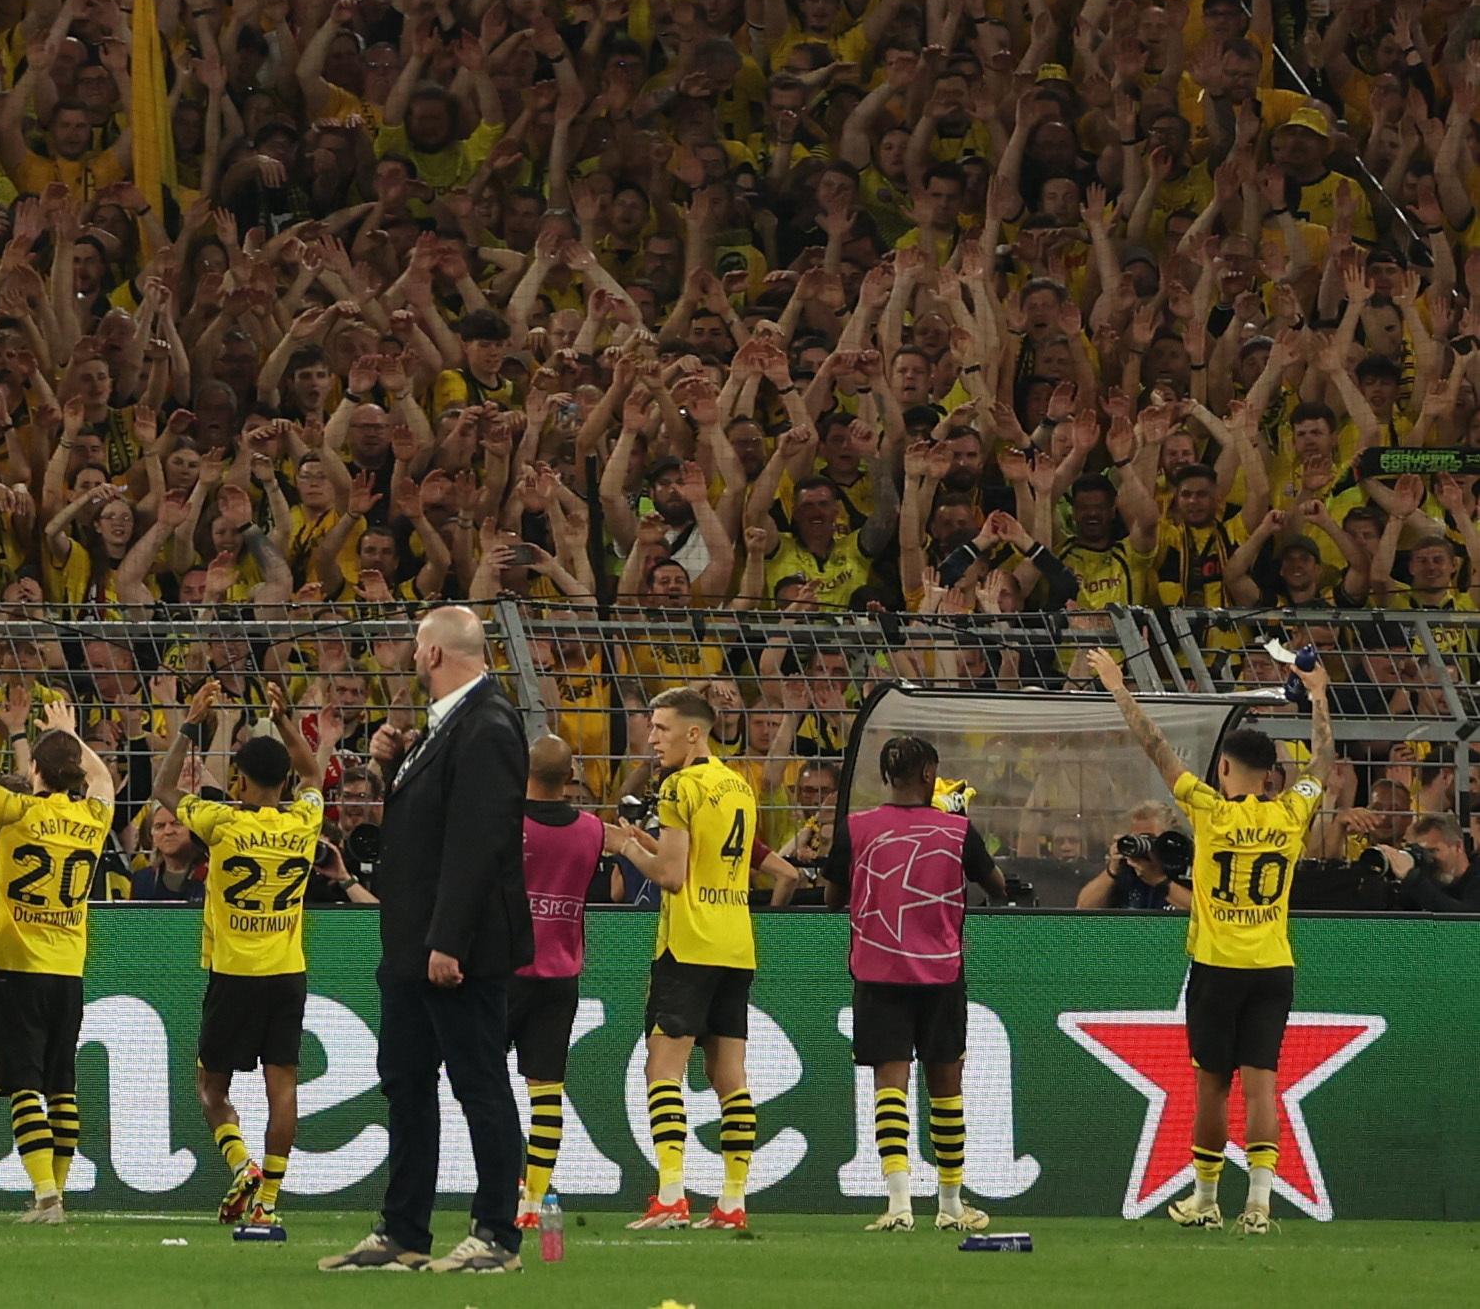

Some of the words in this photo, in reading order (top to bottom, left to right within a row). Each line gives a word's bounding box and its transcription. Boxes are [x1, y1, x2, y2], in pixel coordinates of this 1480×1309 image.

[29, 819, 99, 846] SABITZER
[234, 830, 310, 855] MAATSEN
[719, 807, 747, 861] 4
[1225, 827, 1288, 848] SANCHO
[7, 843, 100, 909] 20
[220, 854, 313, 913] 22
[1211, 851, 1290, 908] 10
[529, 896, 584, 919] ESPECT
